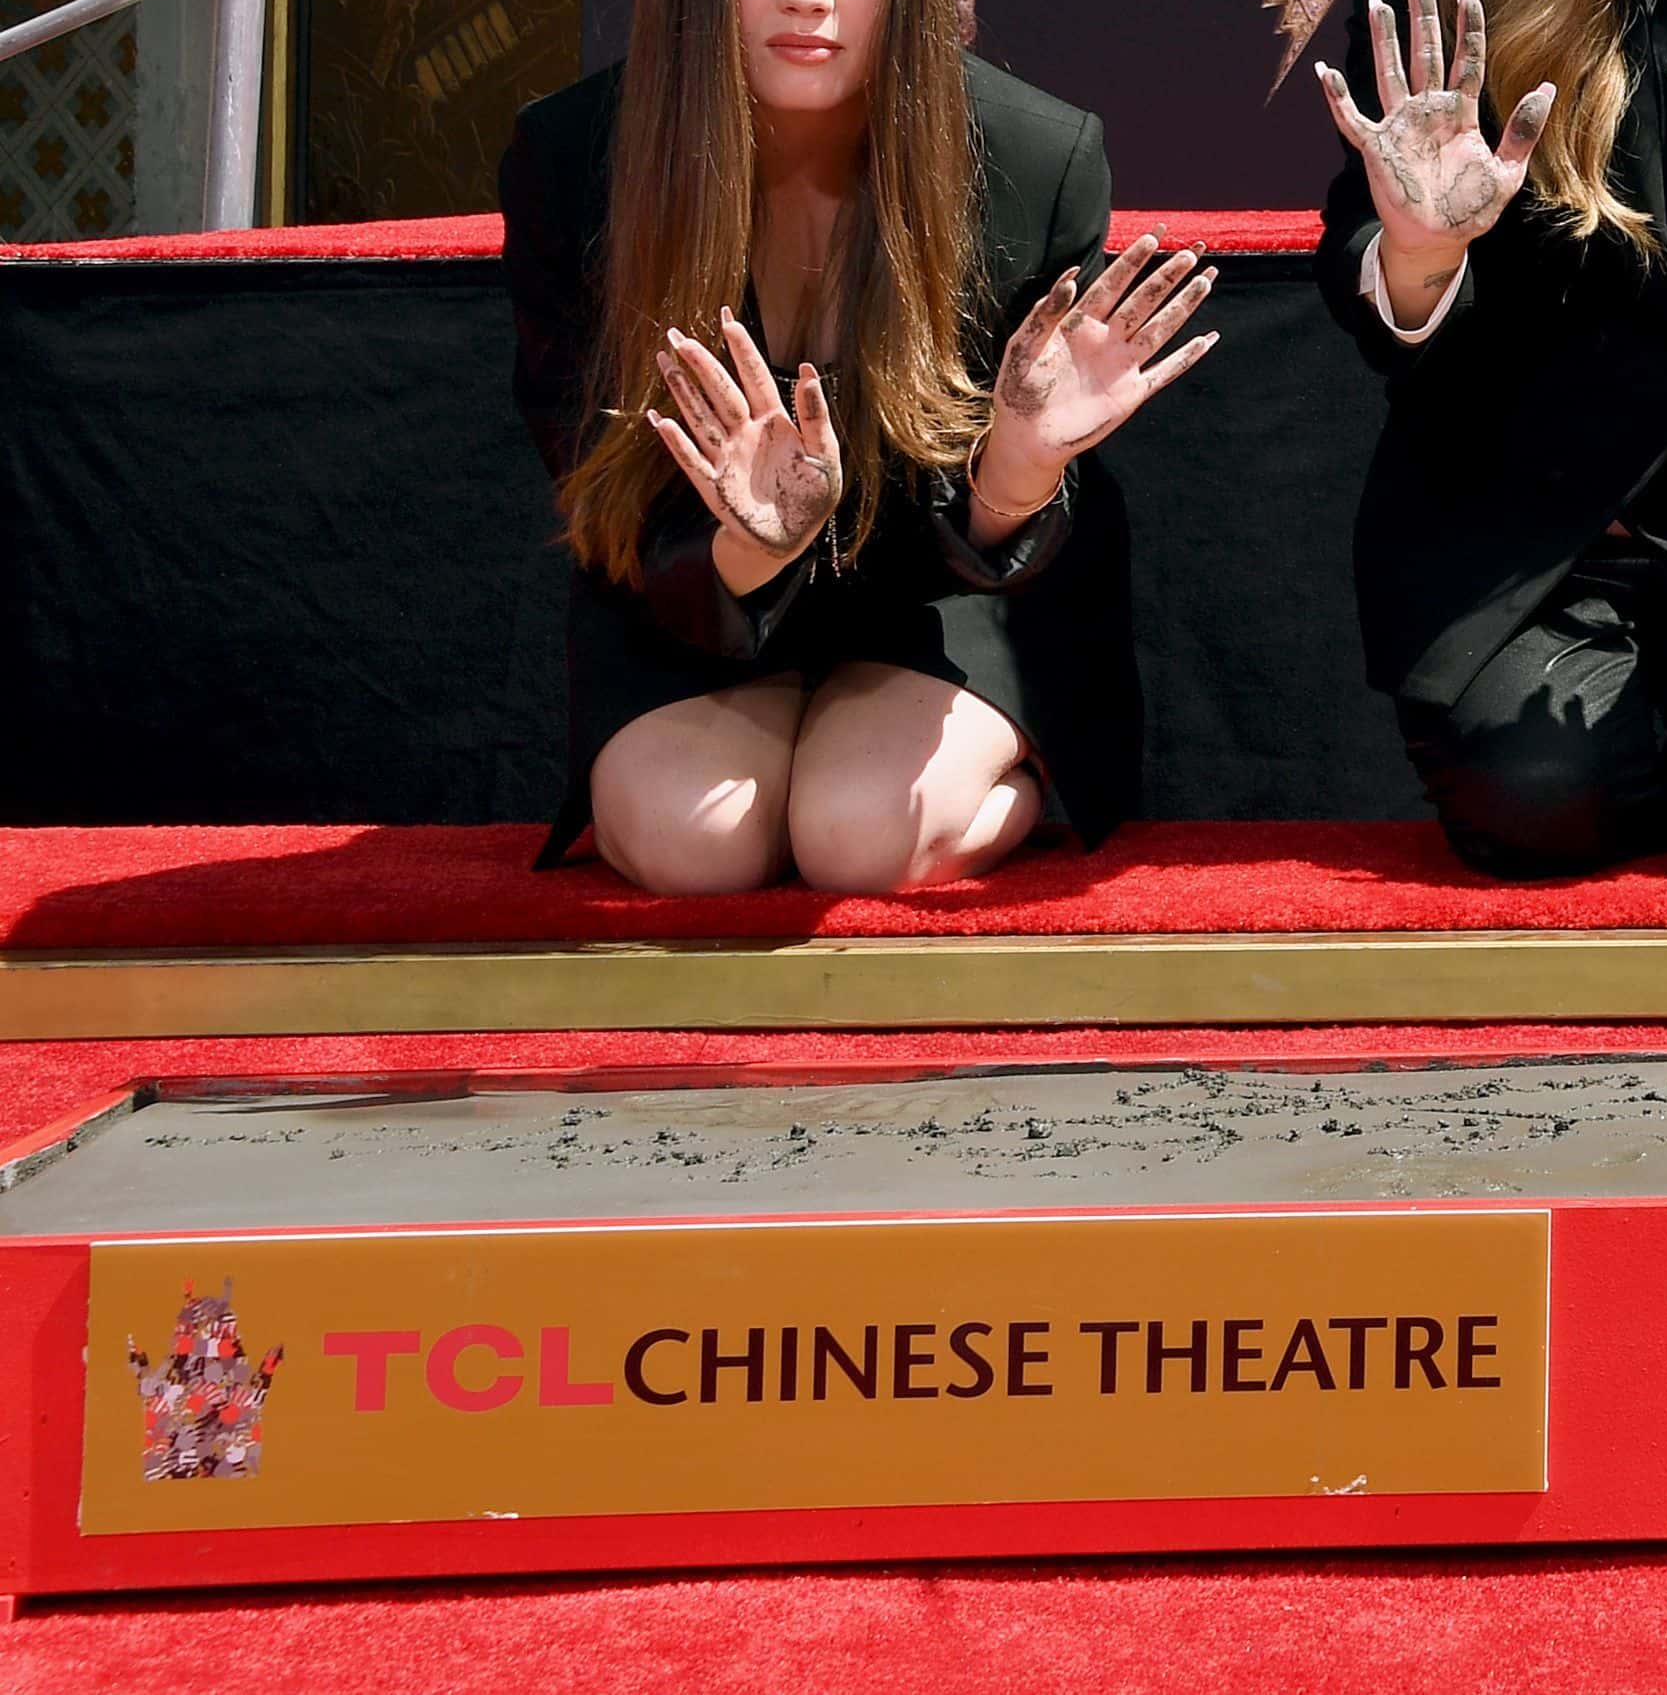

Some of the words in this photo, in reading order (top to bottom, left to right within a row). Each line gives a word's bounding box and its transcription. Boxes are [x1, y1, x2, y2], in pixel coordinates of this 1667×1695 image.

[323, 1323, 615, 1413] TCL
[624, 1322, 1053, 1406] CHINESE
[1079, 1316, 1501, 1394] THEATRE
